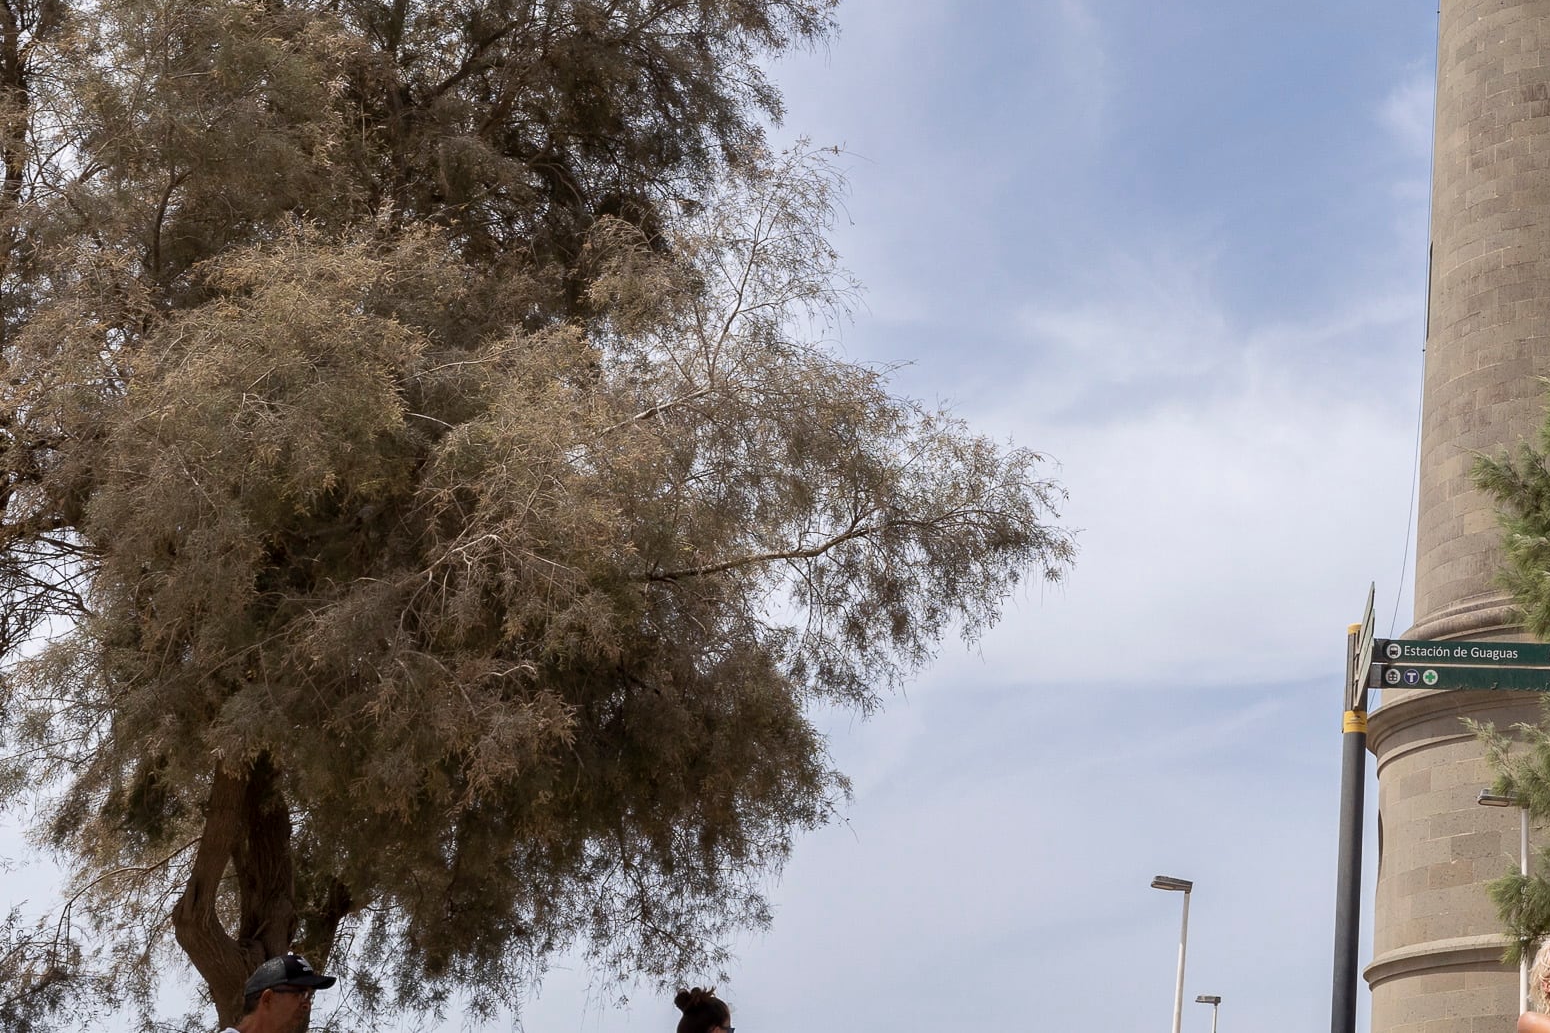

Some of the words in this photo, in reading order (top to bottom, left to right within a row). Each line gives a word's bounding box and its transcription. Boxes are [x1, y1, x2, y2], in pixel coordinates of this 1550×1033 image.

[1403, 645, 1451, 657] Estación
[1453, 646, 1468, 658] de
[1470, 647, 1519, 661] Guaguas
